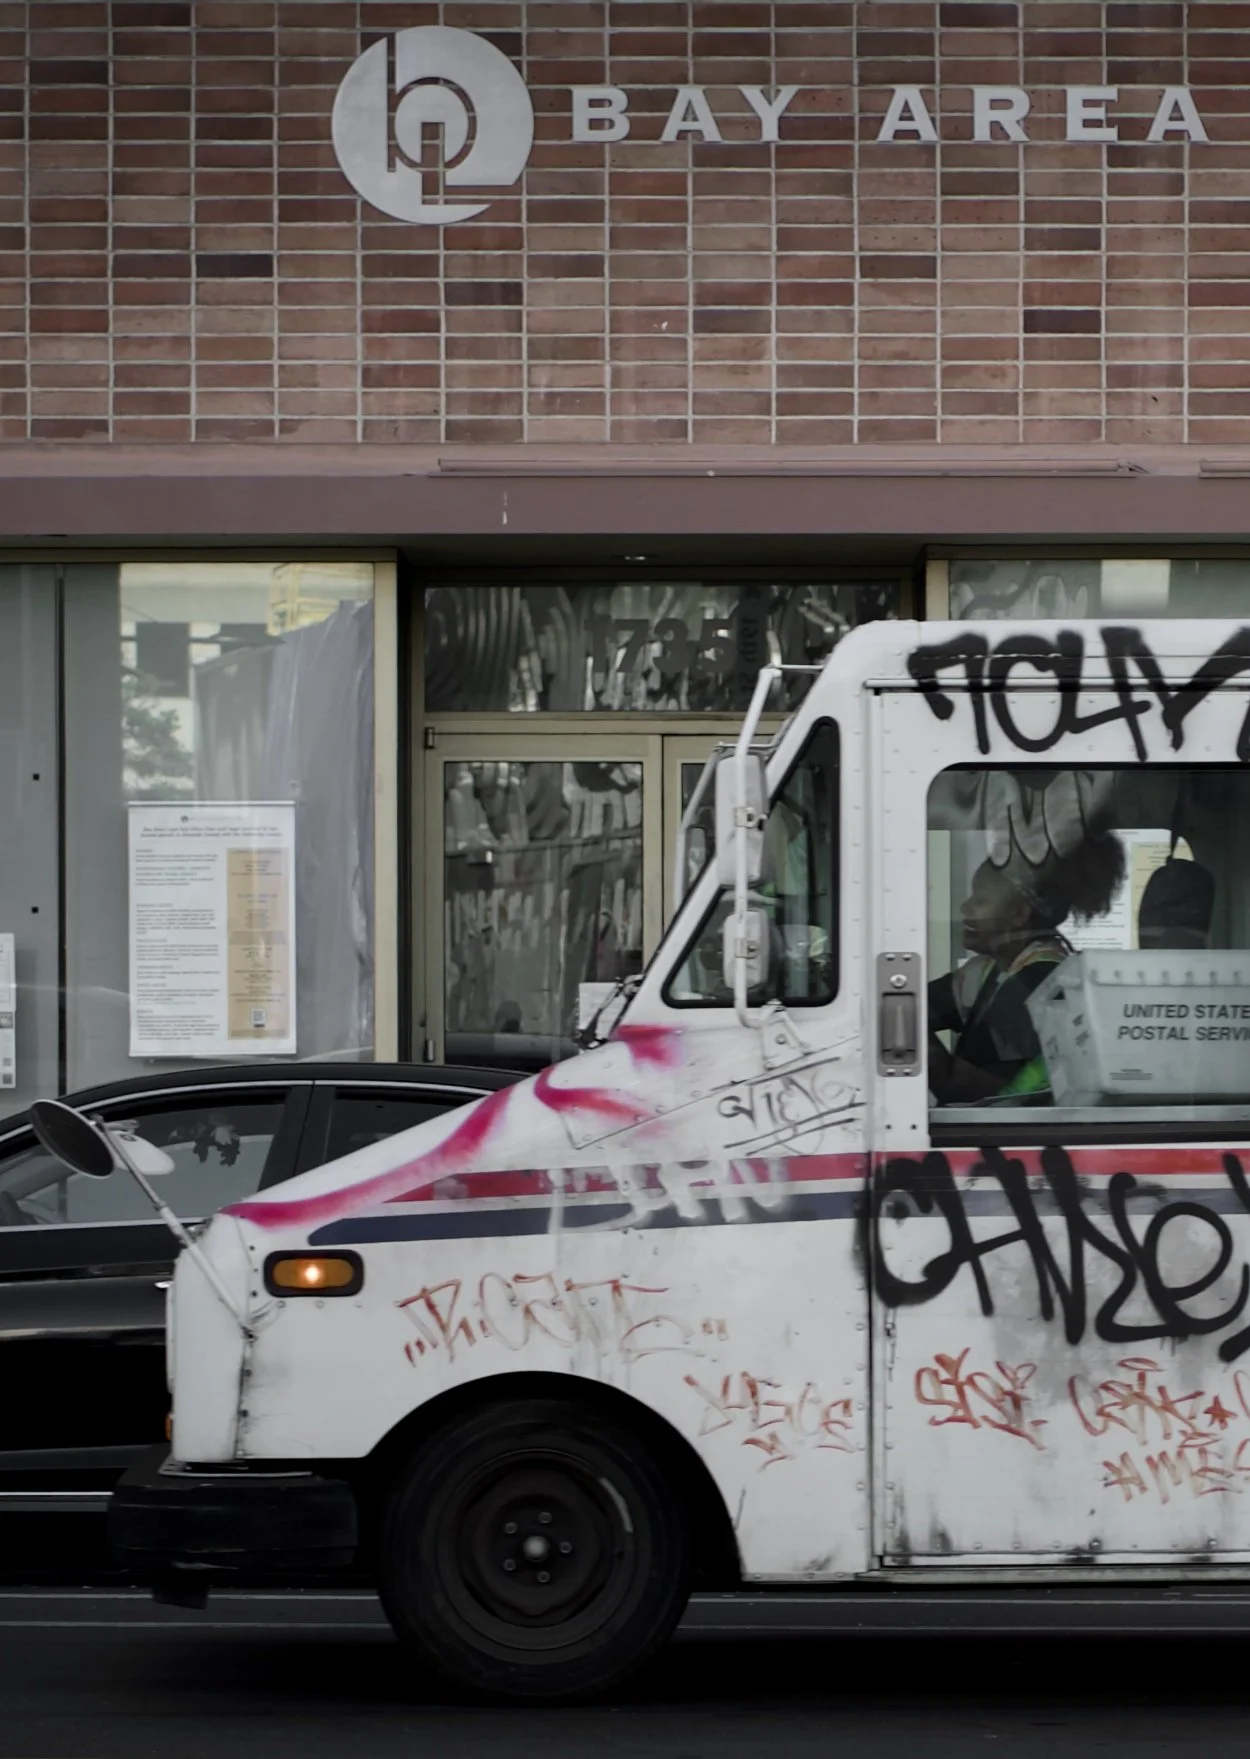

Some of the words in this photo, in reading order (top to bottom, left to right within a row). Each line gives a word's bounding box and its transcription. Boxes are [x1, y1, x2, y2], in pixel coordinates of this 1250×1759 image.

[570, 85, 799, 144] BAY
[876, 85, 1209, 144] AREA
[584, 615, 738, 674] 1735
[1123, 1003, 1190, 1019] UNITED
[1117, 1025, 1190, 1041] POSTAL
